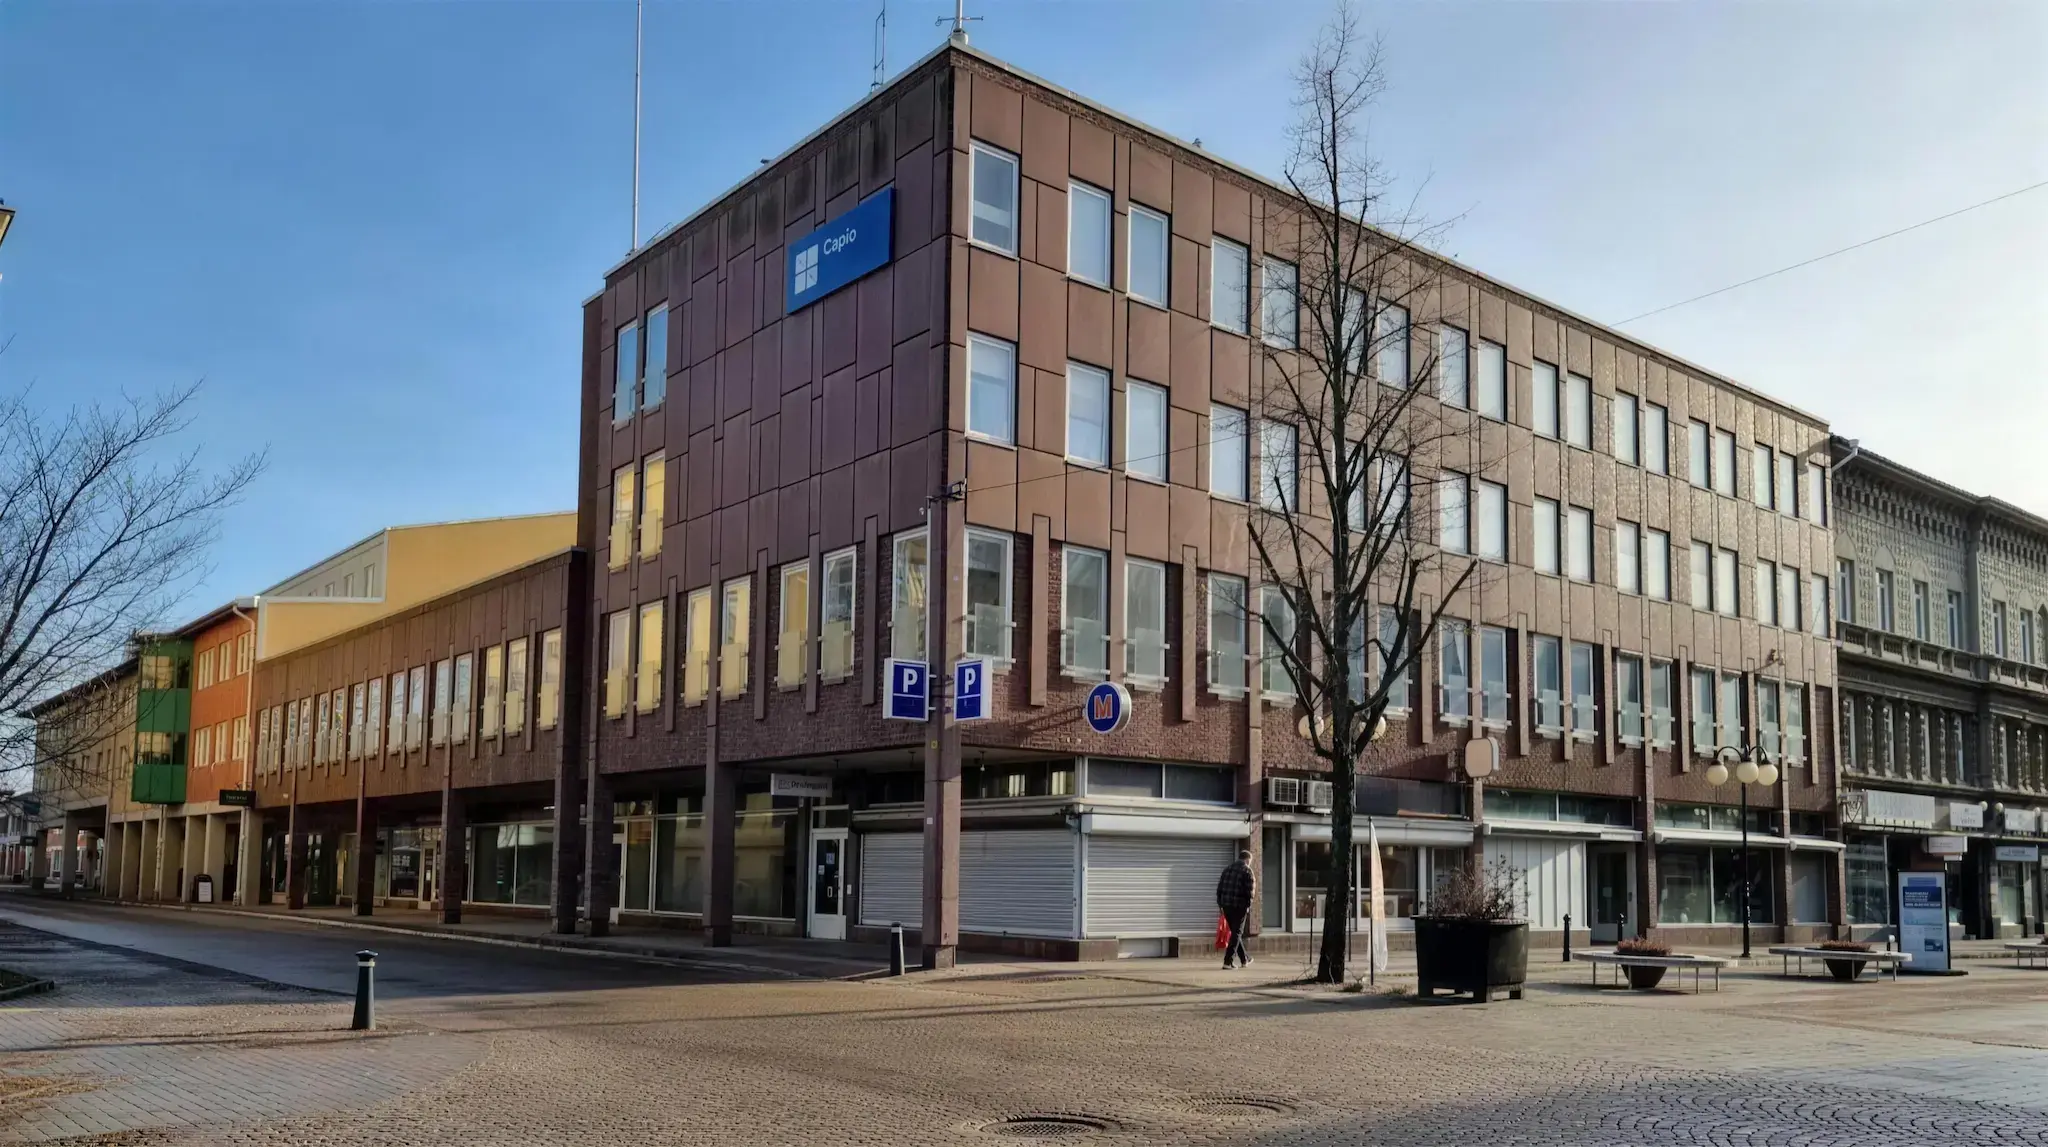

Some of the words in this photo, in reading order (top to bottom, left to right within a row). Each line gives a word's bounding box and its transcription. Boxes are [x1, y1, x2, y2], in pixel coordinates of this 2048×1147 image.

[823, 227, 857, 255] Capio
[902, 668, 918, 693] P
[964, 667, 976, 694] P
[1093, 693, 1113, 720] M
